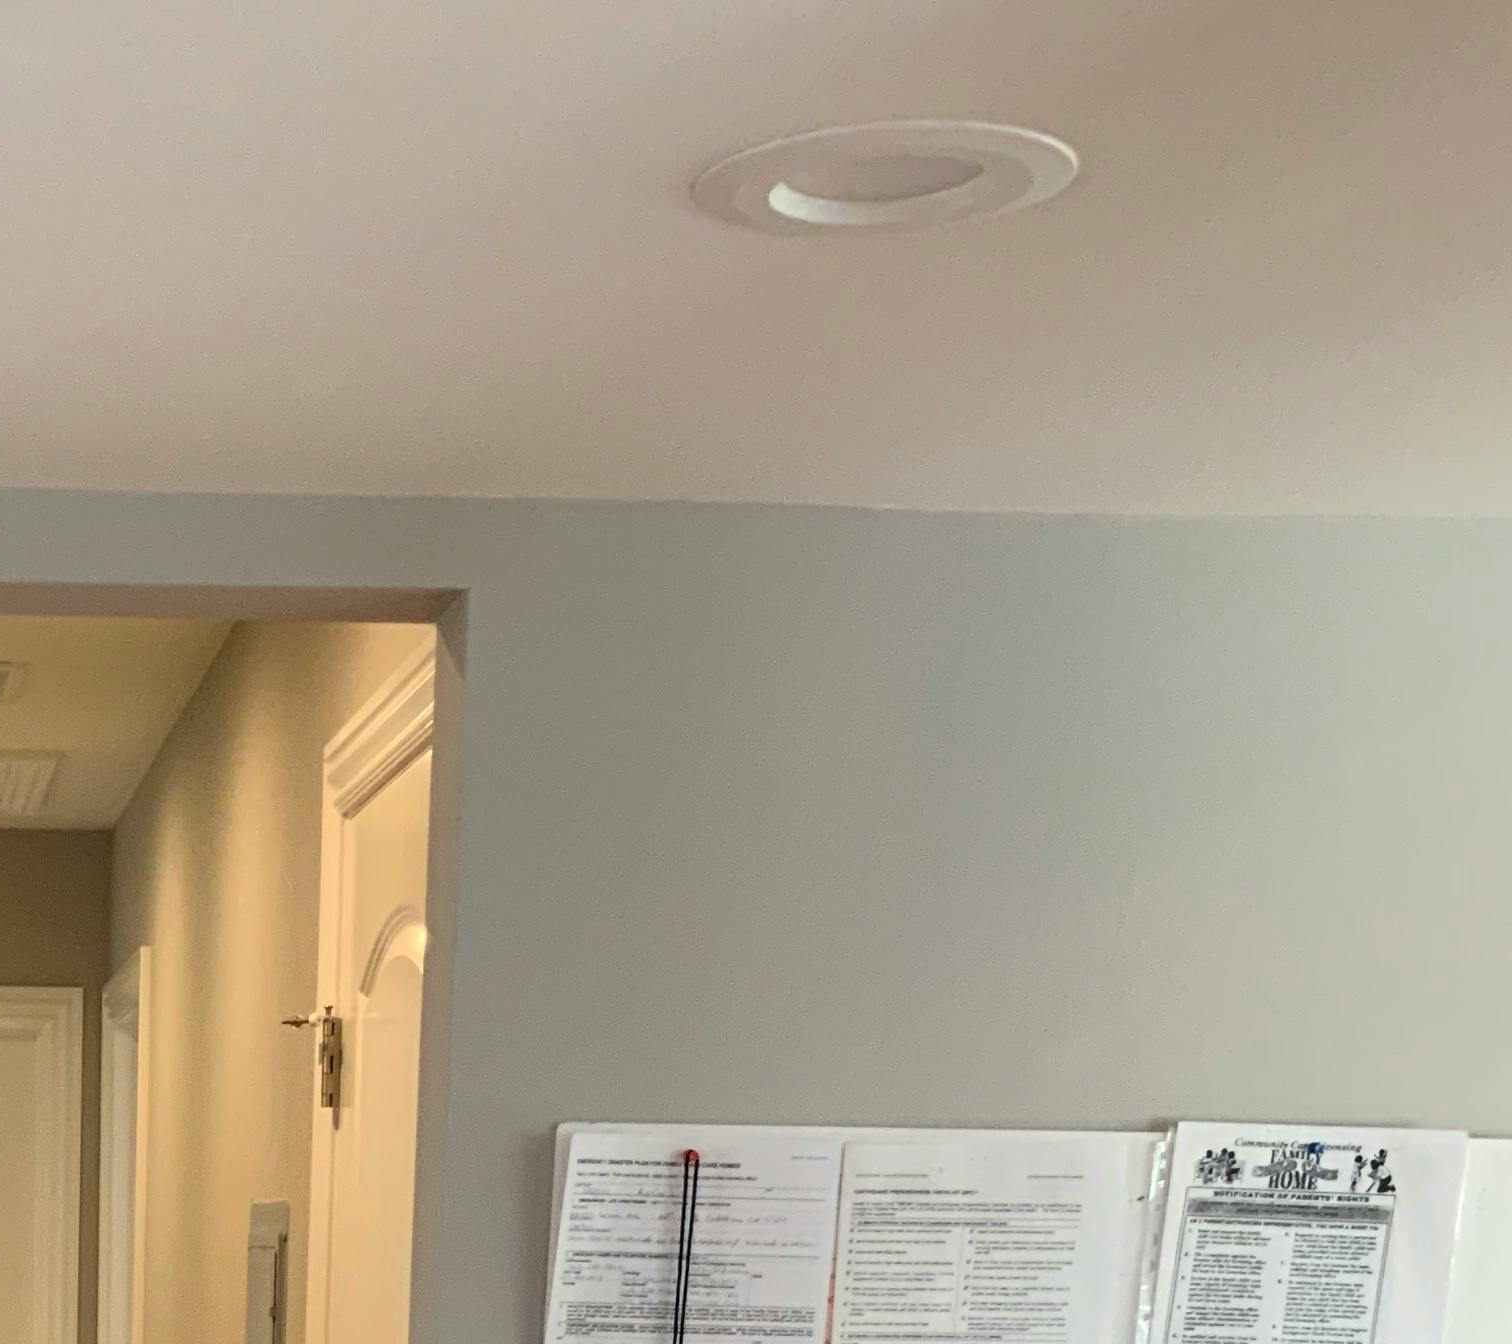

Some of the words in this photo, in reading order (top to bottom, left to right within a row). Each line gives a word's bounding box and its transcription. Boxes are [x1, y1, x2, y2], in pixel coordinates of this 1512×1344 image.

[1234, 1138, 1289, 1149] Community
[1268, 1171, 1318, 1190] HOME
[1214, 1191, 1275, 1199] NOTIFICATION
